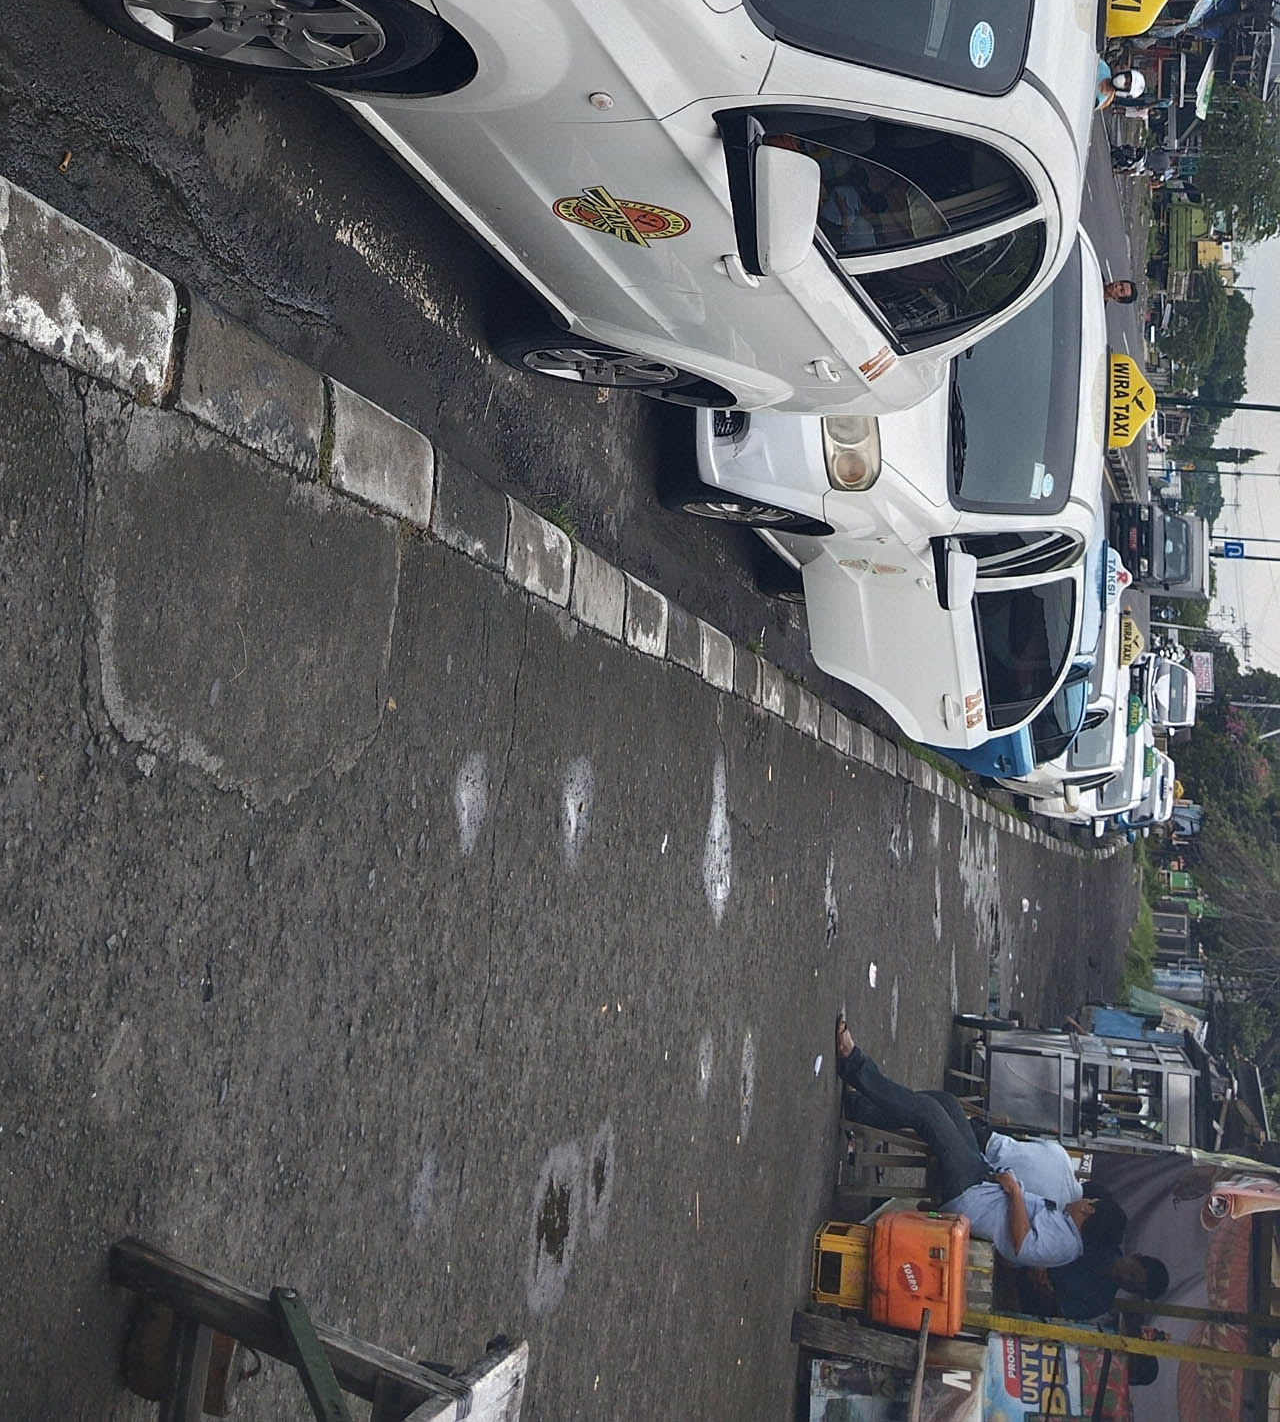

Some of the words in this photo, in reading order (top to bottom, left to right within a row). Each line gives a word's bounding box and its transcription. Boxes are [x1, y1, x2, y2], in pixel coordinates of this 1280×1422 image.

[596, 208, 633, 230] TAXI
[1113, 362, 1130, 399] WIRA
[1113, 404, 1129, 437] TAXI
[1107, 559, 1116, 596] TAKSI
[1123, 621, 1132, 641] WIRA
[1123, 644, 1132, 661] TAXI
[1130, 702, 1138, 727] TAKSI
[903, 1263, 919, 1291] SOSRO
